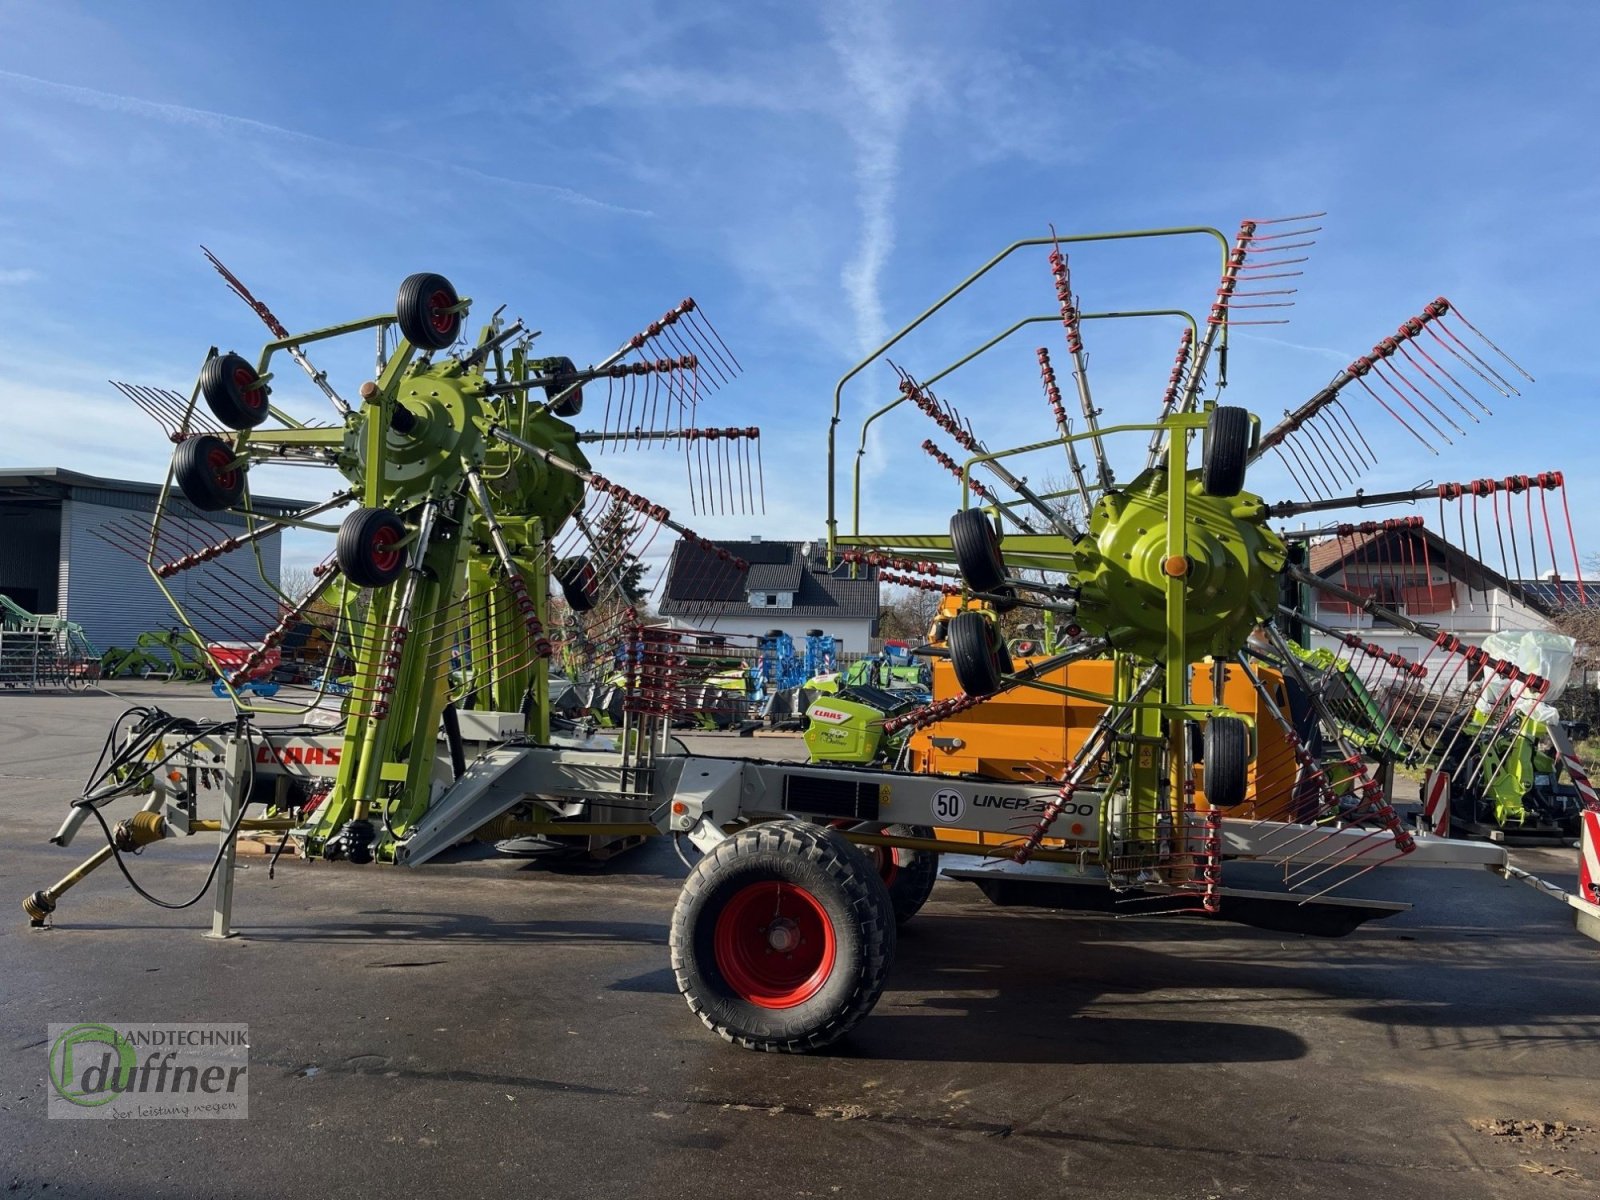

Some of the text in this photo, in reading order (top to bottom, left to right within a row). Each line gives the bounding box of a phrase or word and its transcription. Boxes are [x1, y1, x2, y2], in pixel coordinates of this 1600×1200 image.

[815, 710, 842, 719] CLAAS
[937, 794, 959, 817] 50
[973, 794, 1094, 816] LINER 300
